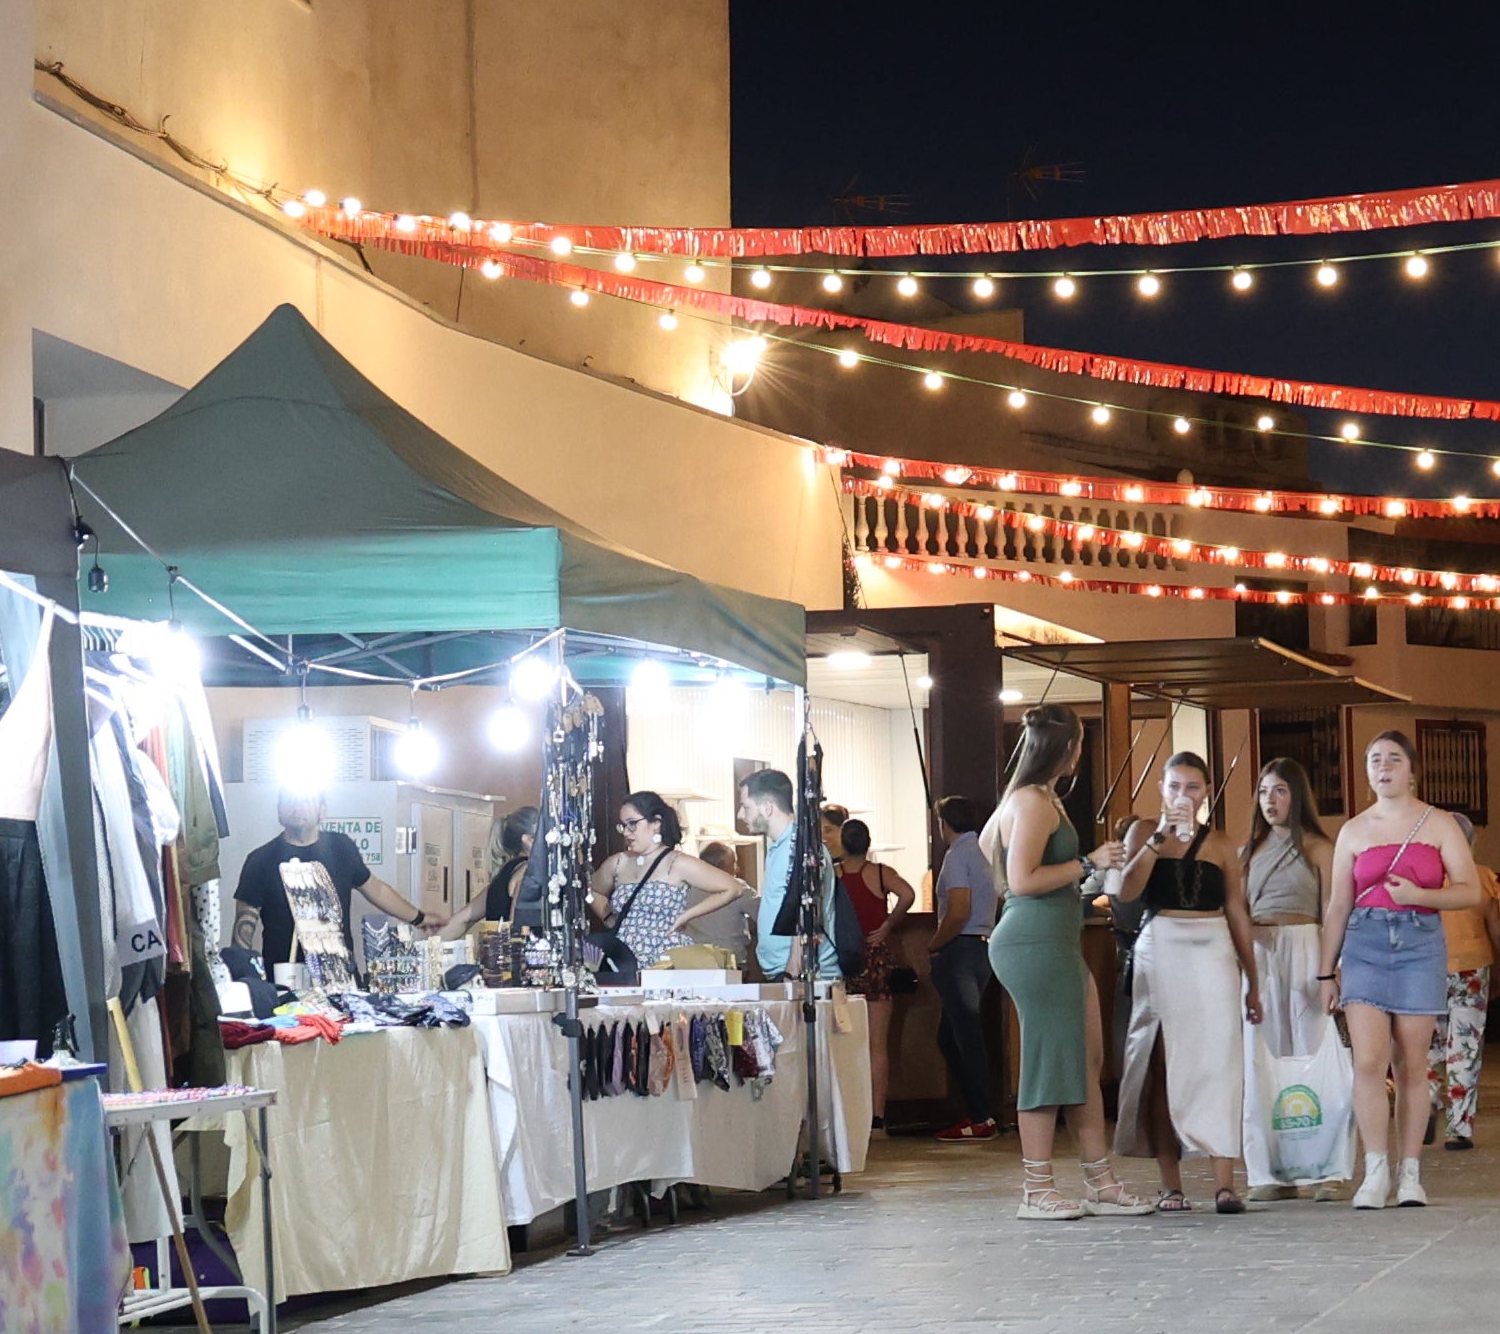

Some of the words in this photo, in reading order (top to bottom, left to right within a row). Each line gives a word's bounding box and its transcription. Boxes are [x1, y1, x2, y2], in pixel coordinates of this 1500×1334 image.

[321, 821, 361, 834] VENTA
[365, 821, 381, 833] DE
[131, 929, 162, 952] CA
